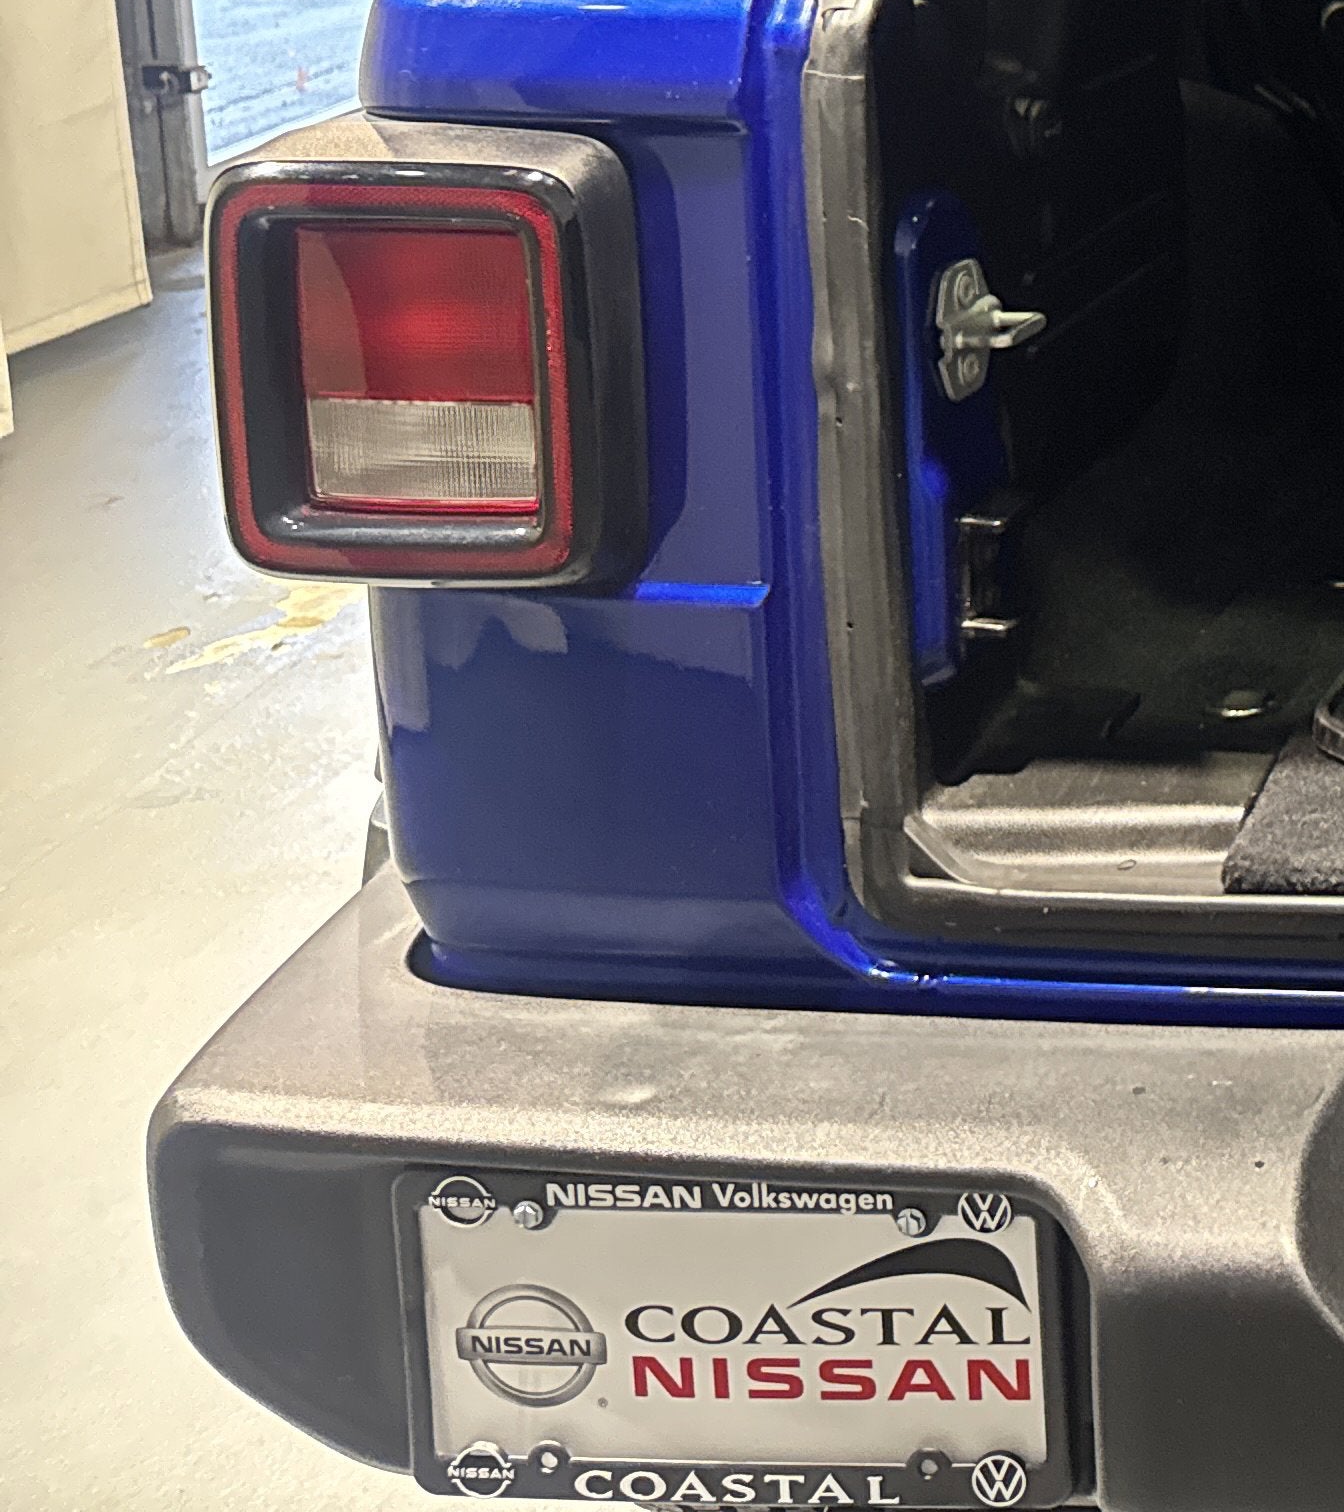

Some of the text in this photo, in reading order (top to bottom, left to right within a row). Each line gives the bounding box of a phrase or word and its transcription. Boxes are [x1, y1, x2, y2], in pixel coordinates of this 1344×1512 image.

[427, 1195, 497, 1209] NISSAN
[545, 1182, 894, 1215] NISSAN Volkswagen
[624, 1302, 1032, 1347] COASTAL
[470, 1334, 592, 1357] NISSAN
[631, 1355, 1032, 1402] NISSAN
[446, 1464, 515, 1480] NISSAN
[573, 1468, 900, 1506] COASTAL
